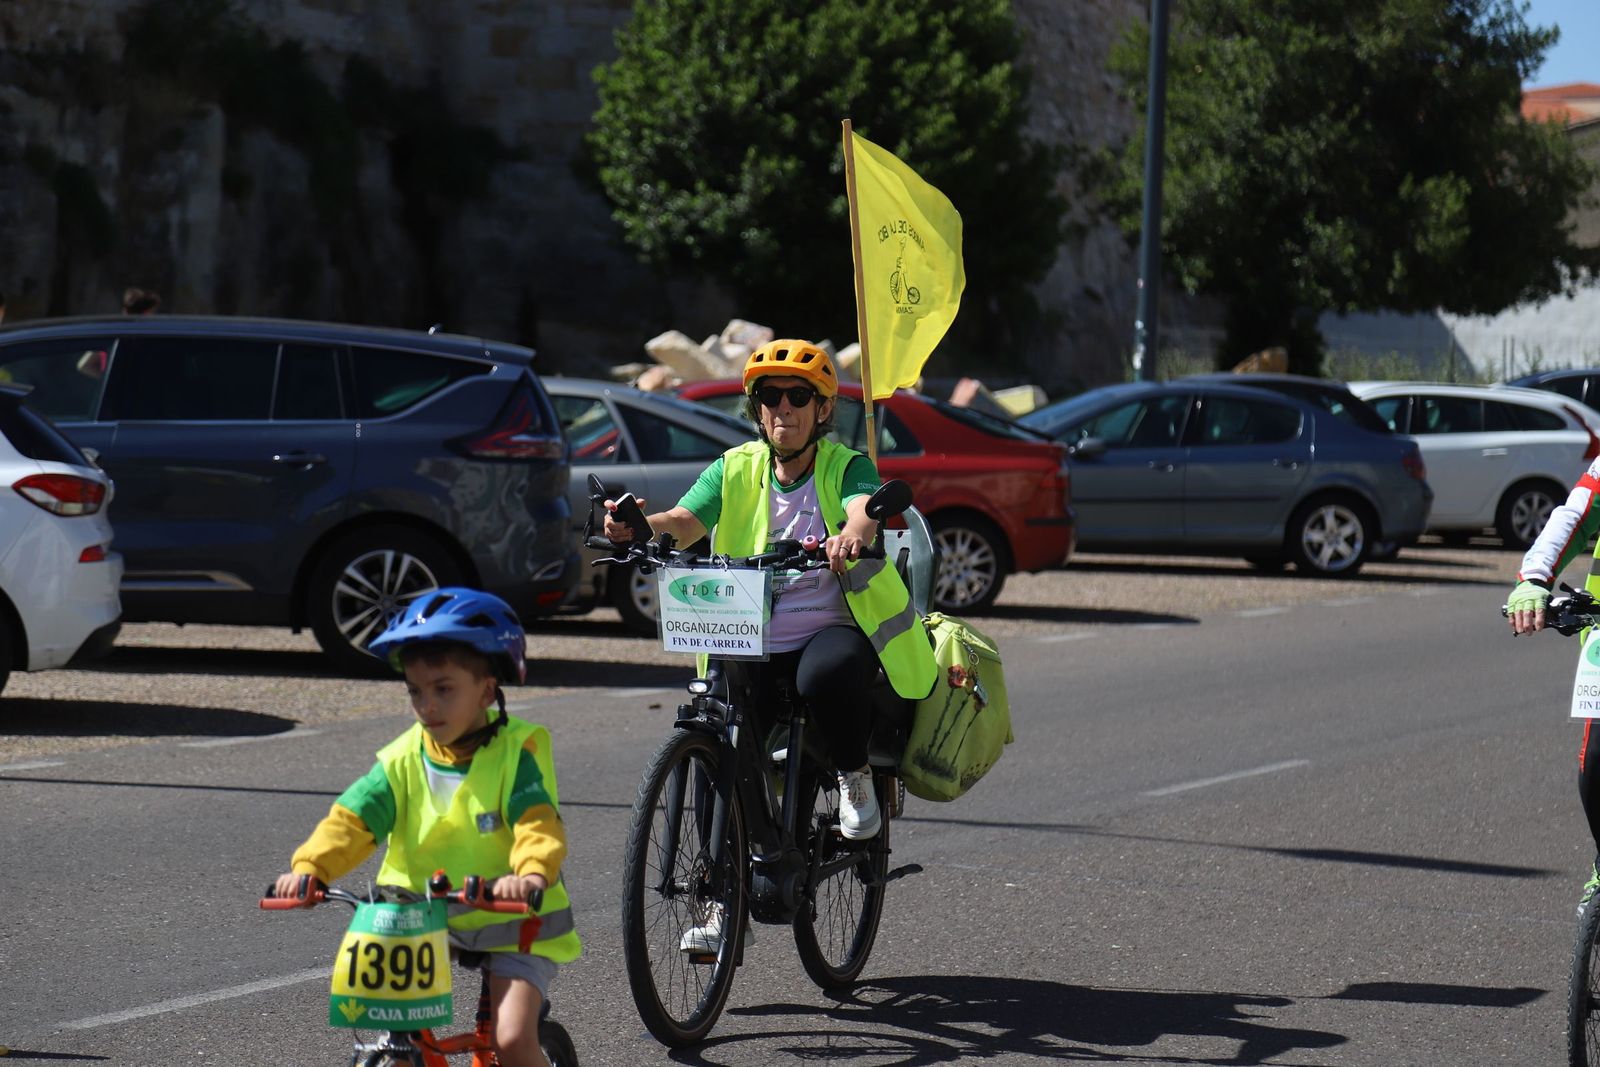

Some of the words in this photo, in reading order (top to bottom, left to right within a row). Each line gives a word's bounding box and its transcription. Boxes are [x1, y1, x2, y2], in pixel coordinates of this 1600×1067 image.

[666, 620, 759, 636] ORGANIZACIÓN
[672, 636, 688, 646] FIN
[690, 638, 702, 647] DE
[704, 639, 752, 649] CARRERA
[1579, 701, 1592, 710] FIN
[347, 940, 435, 991] 1399
[368, 1007, 404, 1020] CAJA
[407, 1004, 449, 1020] RURAL
